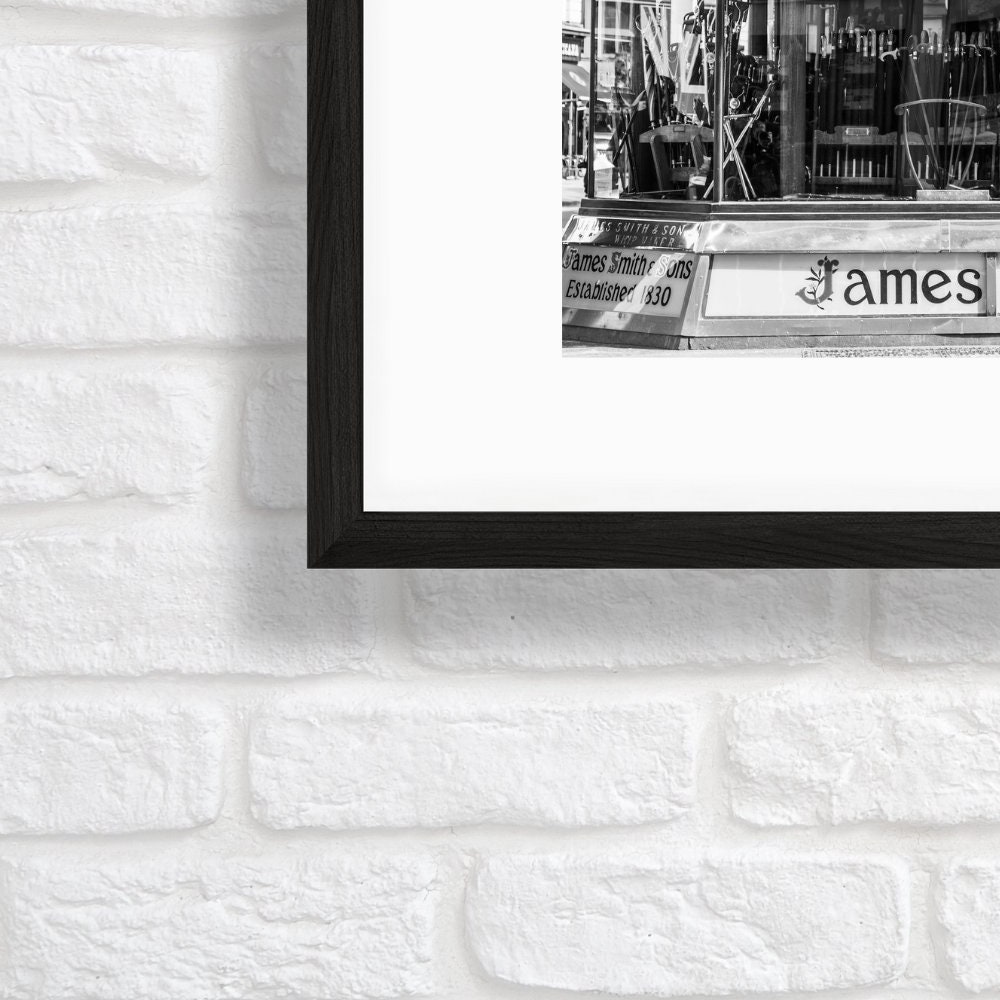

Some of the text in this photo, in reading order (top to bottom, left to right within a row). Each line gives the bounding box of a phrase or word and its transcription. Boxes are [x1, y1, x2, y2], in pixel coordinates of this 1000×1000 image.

[562, 248, 607, 273] James
[608, 251, 647, 276] Smith
[655, 254, 693, 280] Sons
[565, 279, 673, 307] Established 1830
[795, 256, 983, 307] James
